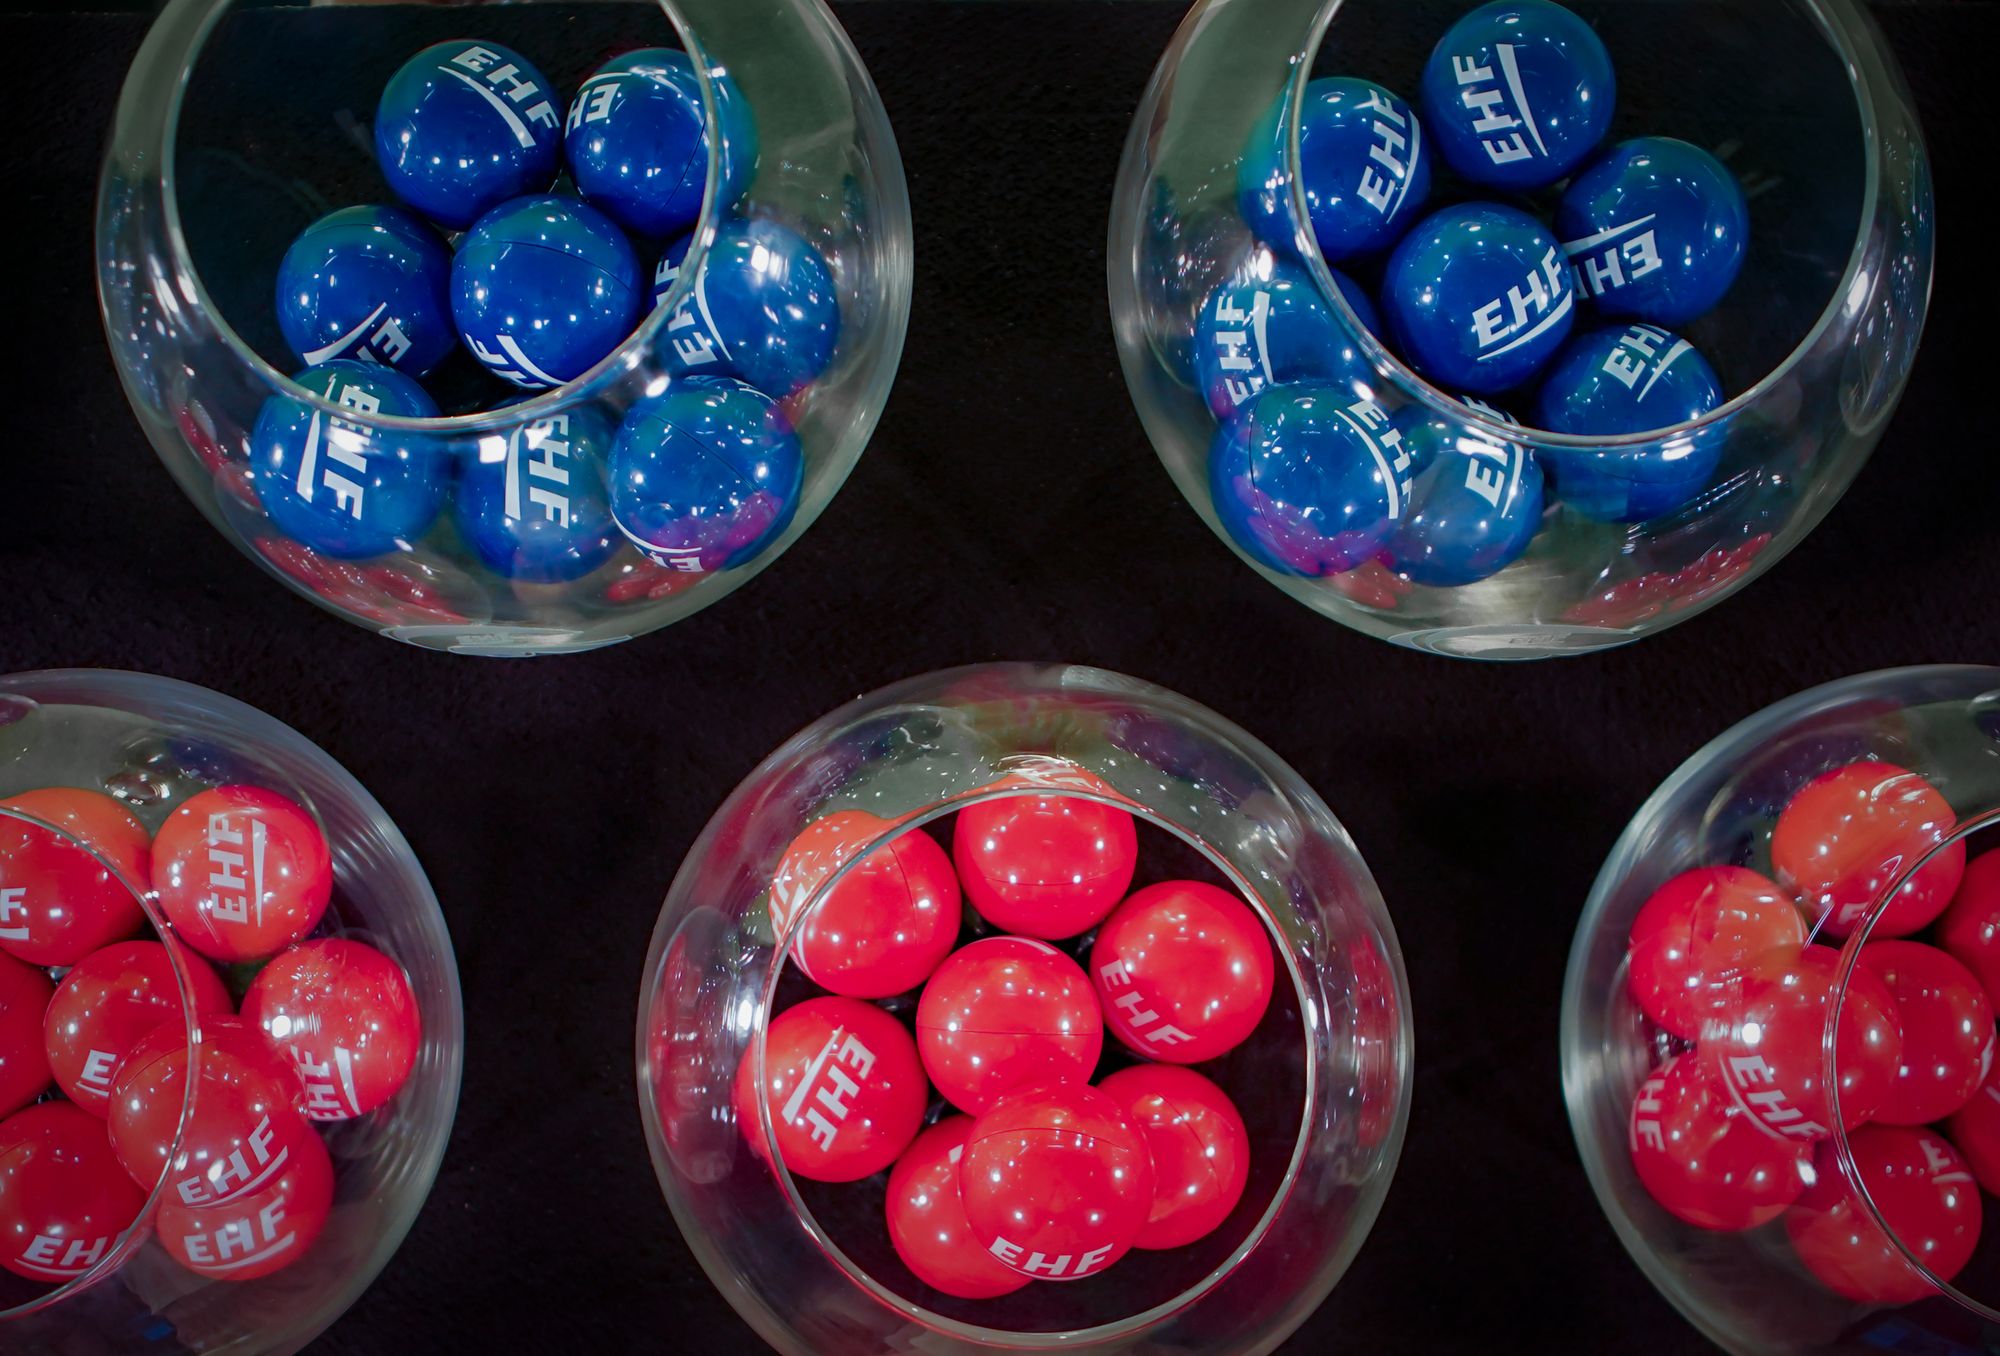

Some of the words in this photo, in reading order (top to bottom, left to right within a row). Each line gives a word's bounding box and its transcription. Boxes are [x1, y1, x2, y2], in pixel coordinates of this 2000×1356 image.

[452, 45, 560, 128] EHF
[1452, 54, 1533, 165] EHF
[1357, 89, 1405, 214] EHF
[1472, 245, 1563, 349] EHF
[1216, 295, 1262, 406] EHF
[1602, 323, 1671, 390] EH
[208, 813, 249, 925] EHF
[1101, 959, 1197, 1047] EHF
[289, 1045, 349, 1121] EHF
[805, 1034, 877, 1152] EHF
[1729, 1055, 1828, 1136] EHF
[176, 1114, 278, 1204] EHF
[184, 1197, 286, 1264] EHF
[988, 1236, 1114, 1275] EHF
